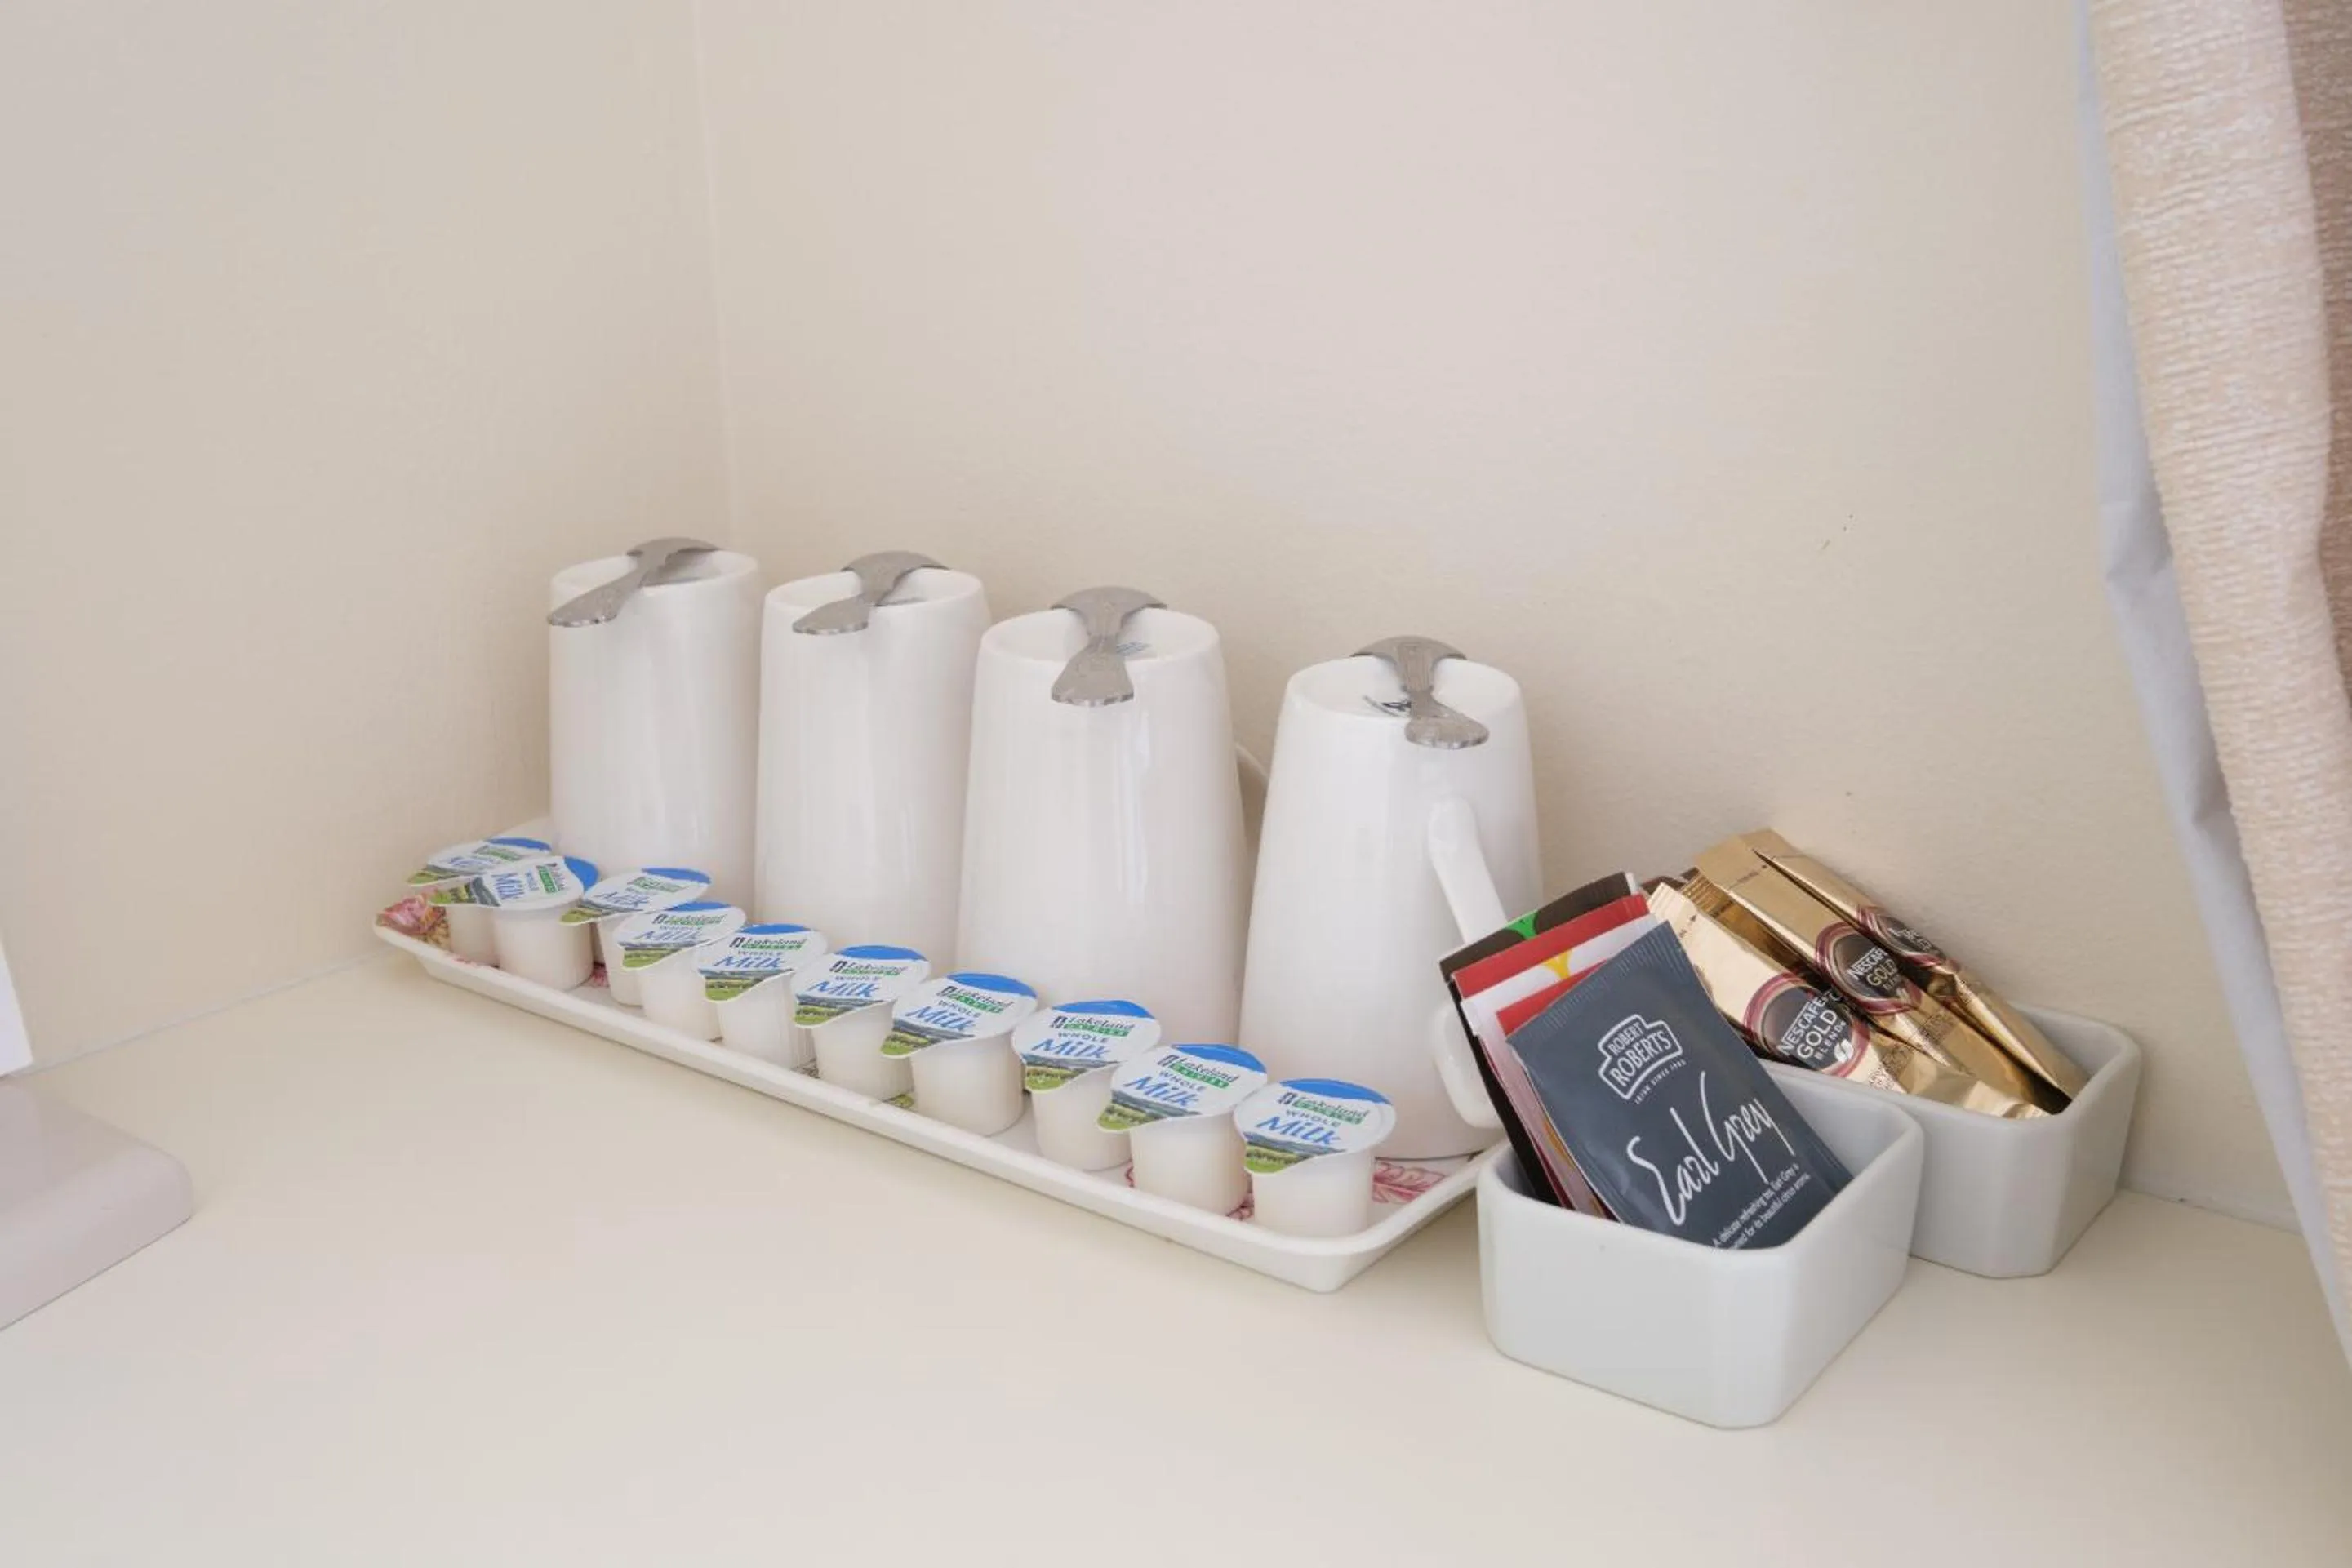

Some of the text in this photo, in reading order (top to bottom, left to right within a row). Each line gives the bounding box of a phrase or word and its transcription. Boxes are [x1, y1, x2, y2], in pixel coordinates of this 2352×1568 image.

[713, 956, 786, 968] Milk
[1866, 958, 1898, 986] GOLD
[806, 980, 879, 997] Milk
[904, 1006, 976, 1031] Milk
[1069, 1016, 1136, 1030] Lakeland
[1057, 1031, 1110, 1043] WHOLE
[1607, 1022, 1644, 1056] ROBERT
[1796, 1009, 1838, 1059] GOLD
[1814, 1022, 1843, 1060] BLEND
[1030, 1038, 1111, 1059] Milk
[1610, 1030, 1672, 1087] ROBERTS
[1178, 1057, 1240, 1083] Lakeland
[1123, 1075, 1200, 1107] Milk
[1255, 1116, 1341, 1145] Milk
[1285, 1108, 1342, 1128] WHOLE
[1626, 1070, 1795, 1226] Earl Grey
